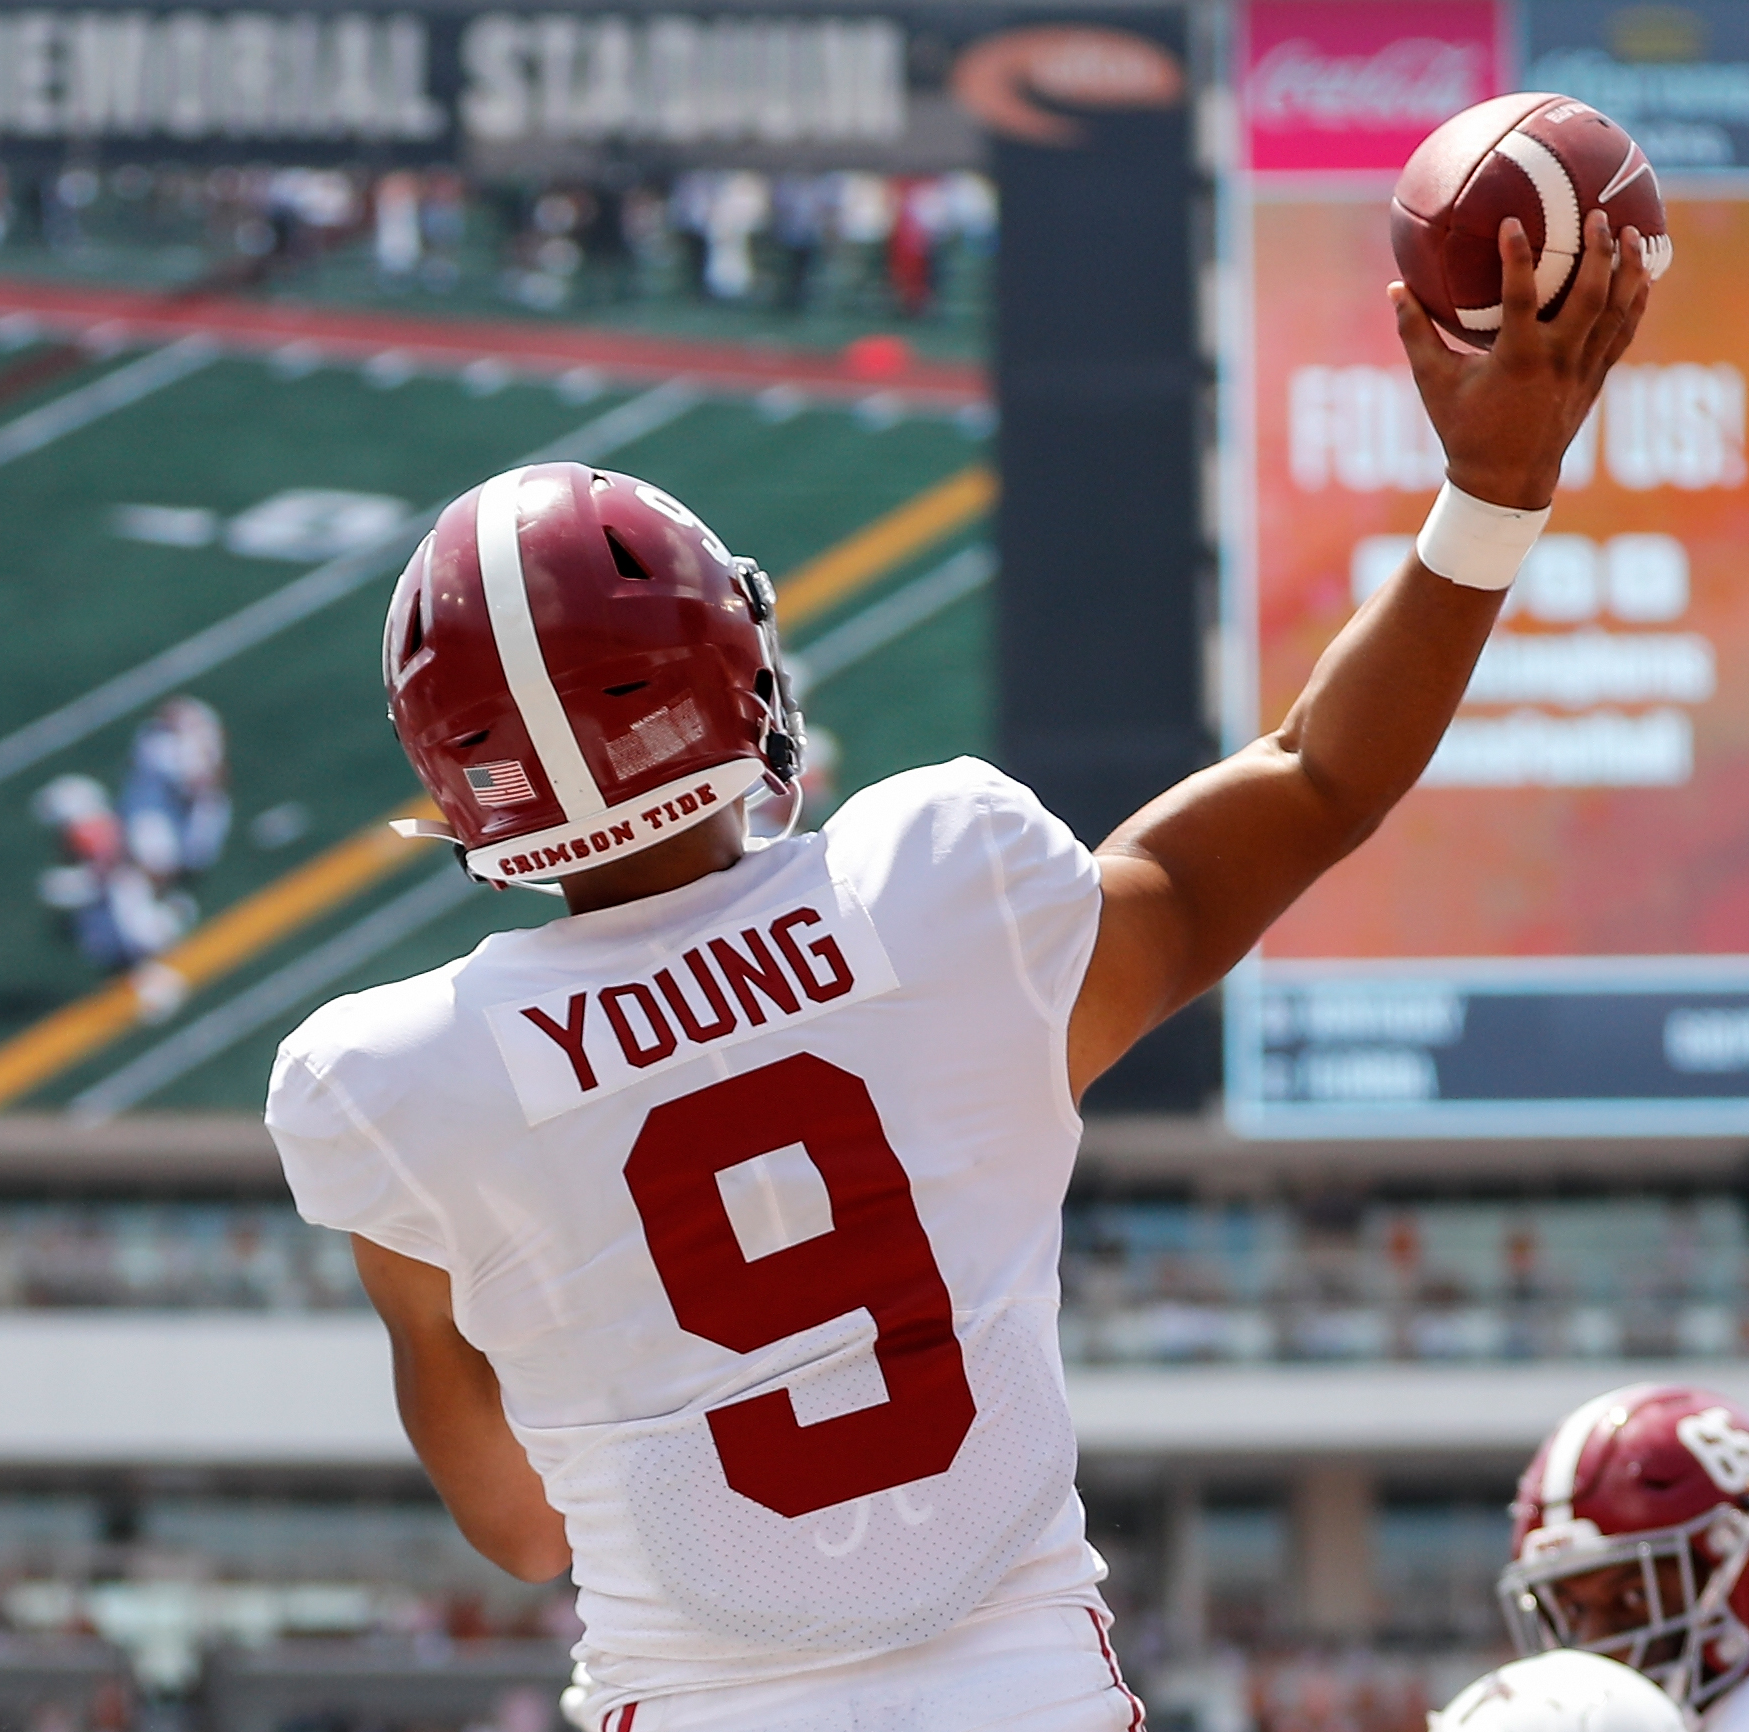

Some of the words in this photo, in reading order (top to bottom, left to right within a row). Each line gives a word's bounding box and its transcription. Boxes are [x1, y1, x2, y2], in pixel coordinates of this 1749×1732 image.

[460, 12, 908, 142] STADIUM
[498, 819, 635, 877] CRIMSON
[641, 783, 718, 830] TIDE
[520, 906, 855, 1092] YOUNG
[623, 1051, 978, 1519] 9
